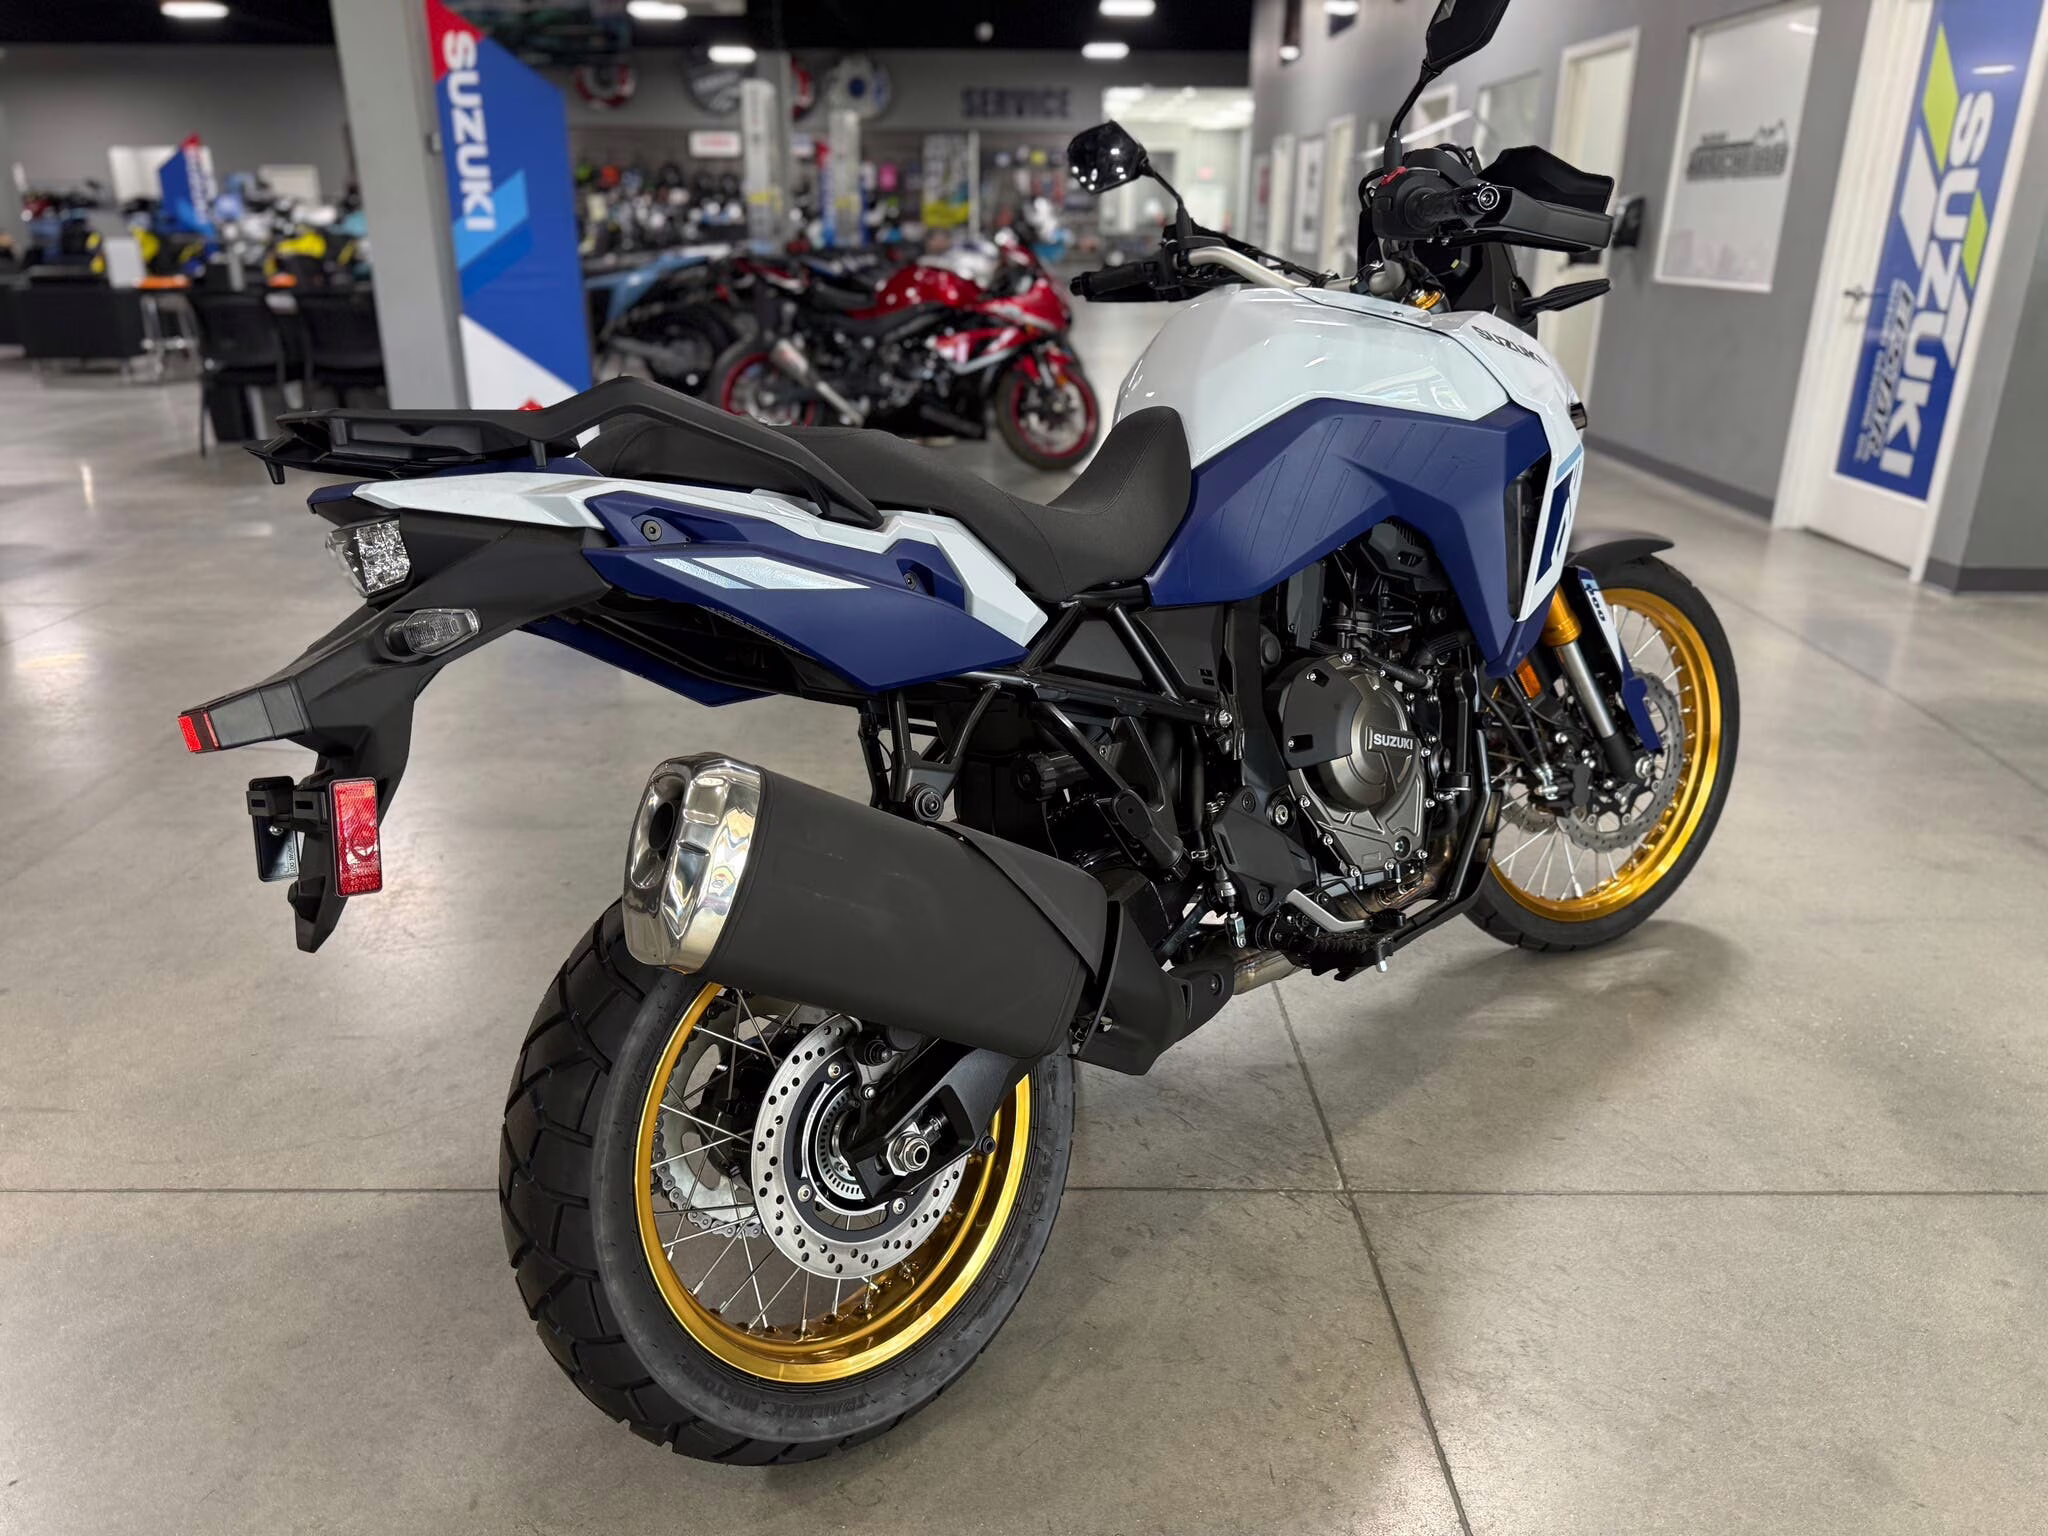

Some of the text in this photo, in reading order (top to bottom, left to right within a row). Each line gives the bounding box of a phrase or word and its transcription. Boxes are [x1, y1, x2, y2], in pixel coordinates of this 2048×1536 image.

[962, 86, 1070, 118] SERVICE
[442, 29, 496, 231] SUZUKI
[1878, 91, 1994, 478] SUZUKI
[1471, 325, 1549, 367] SUZUKI
[1373, 733, 1413, 750] SUZUKI
